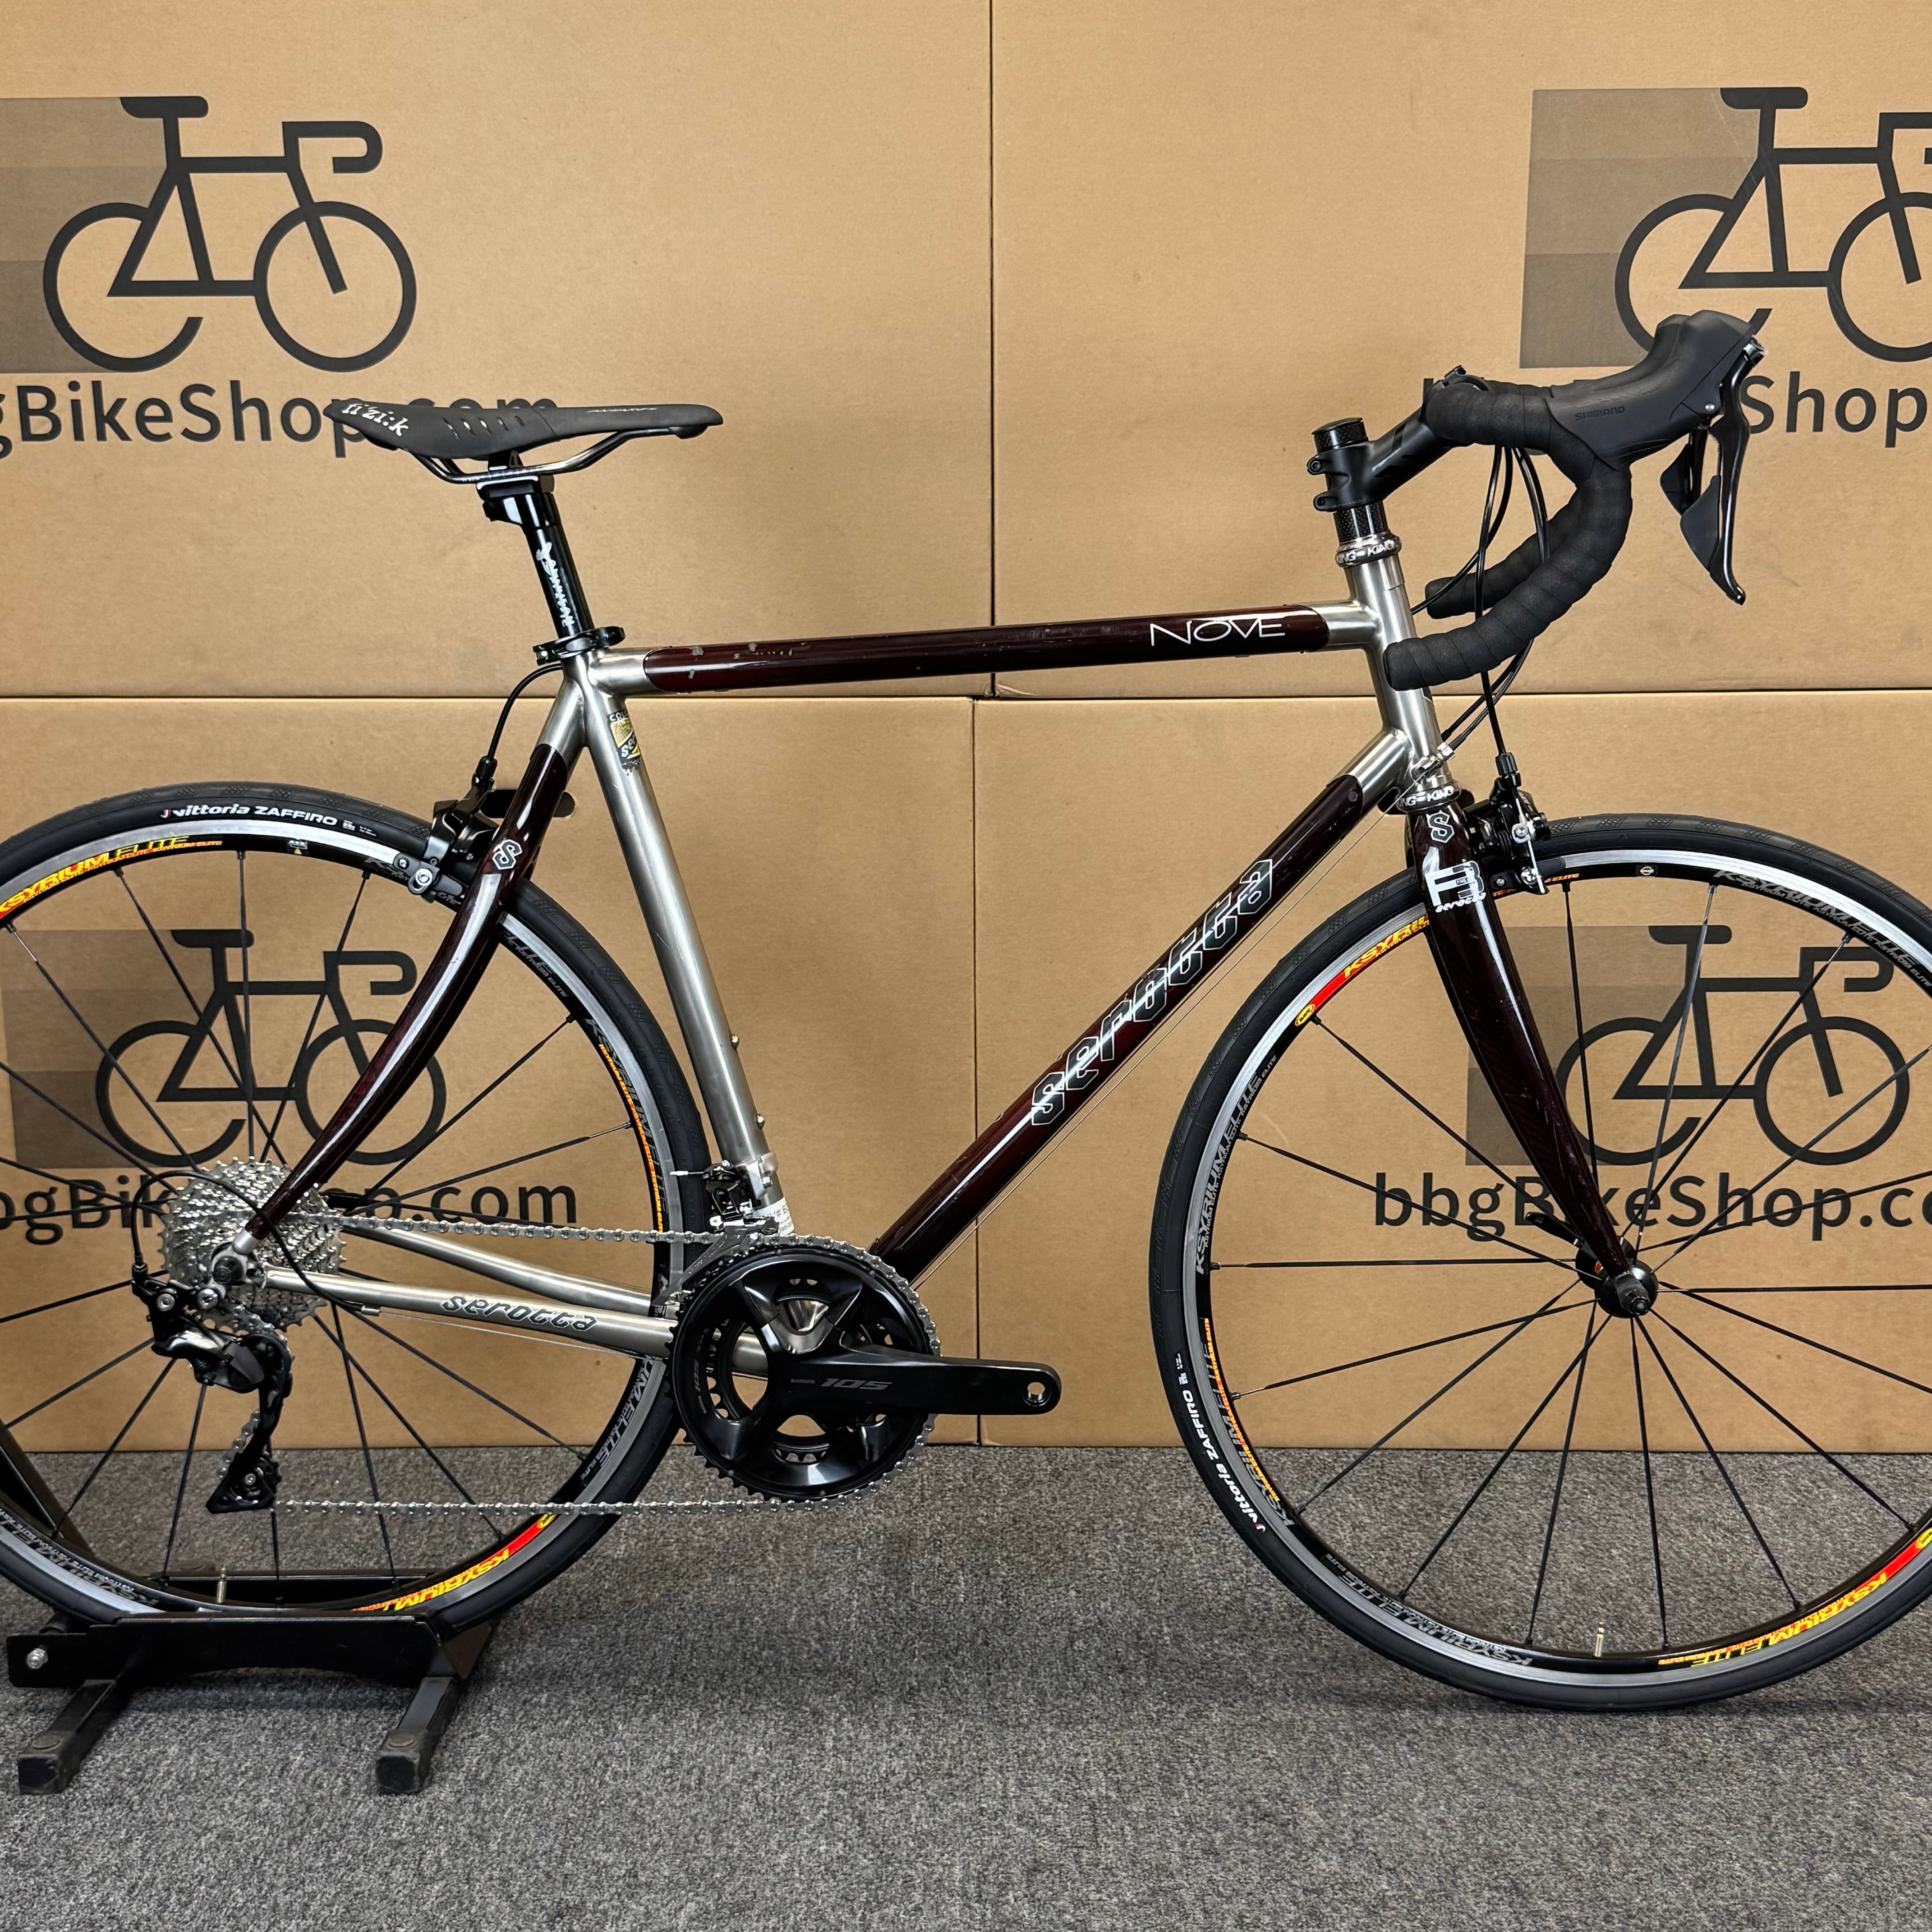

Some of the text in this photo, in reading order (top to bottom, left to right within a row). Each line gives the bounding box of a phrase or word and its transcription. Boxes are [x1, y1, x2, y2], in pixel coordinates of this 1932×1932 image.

[1575, 406, 1625, 421] SHIMANO
[1149, 617, 1285, 646] NOVE
[173, 804, 249, 817] vittoria
[254, 805, 337, 825] ZAFFIRO
[1196, 1143, 1227, 1274] KSYRIUM
[440, 1294, 597, 1332] serotta
[821, 1378, 892, 1390] 105
[1182, 1388, 1219, 1461] ZAFFIRO
[1214, 1461, 1260, 1523] vittoria
